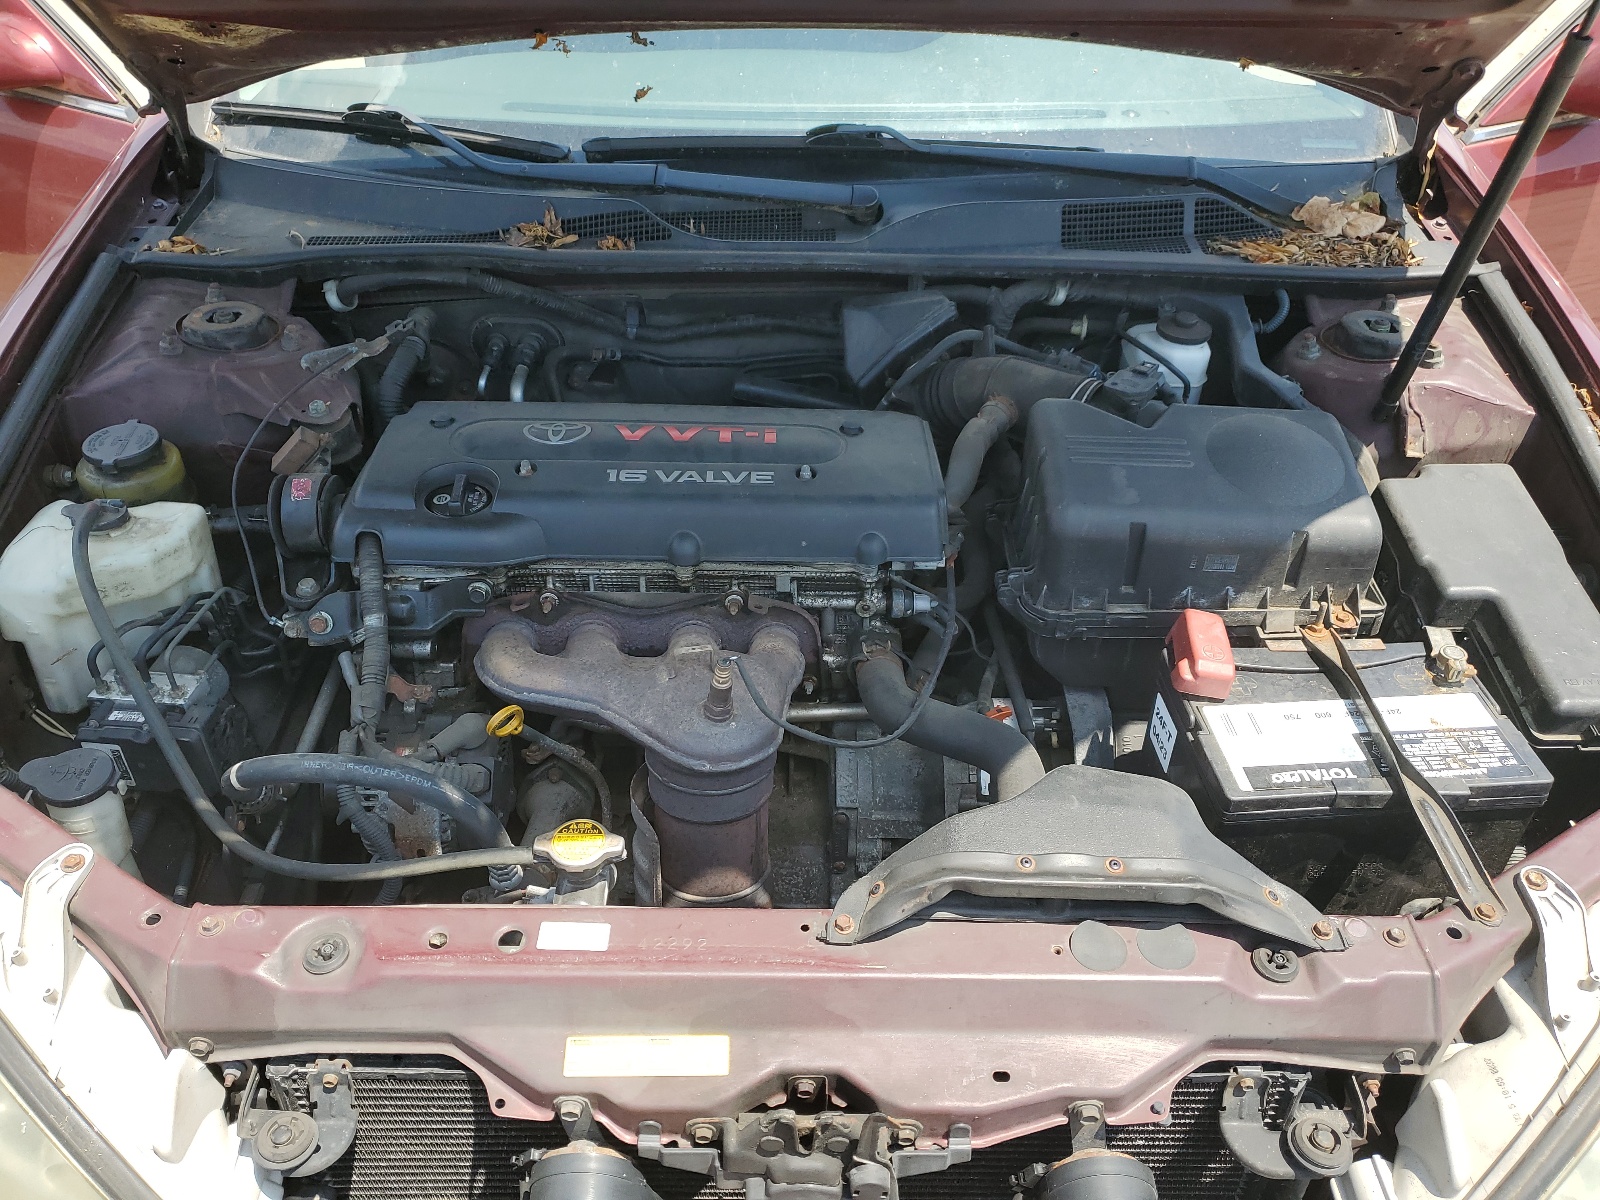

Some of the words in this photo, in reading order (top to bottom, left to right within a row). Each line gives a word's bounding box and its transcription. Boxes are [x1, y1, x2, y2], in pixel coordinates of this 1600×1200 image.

[614, 424, 777, 443] VVT-i
[607, 469, 647, 482] 16
[655, 470, 775, 484] VALVE
